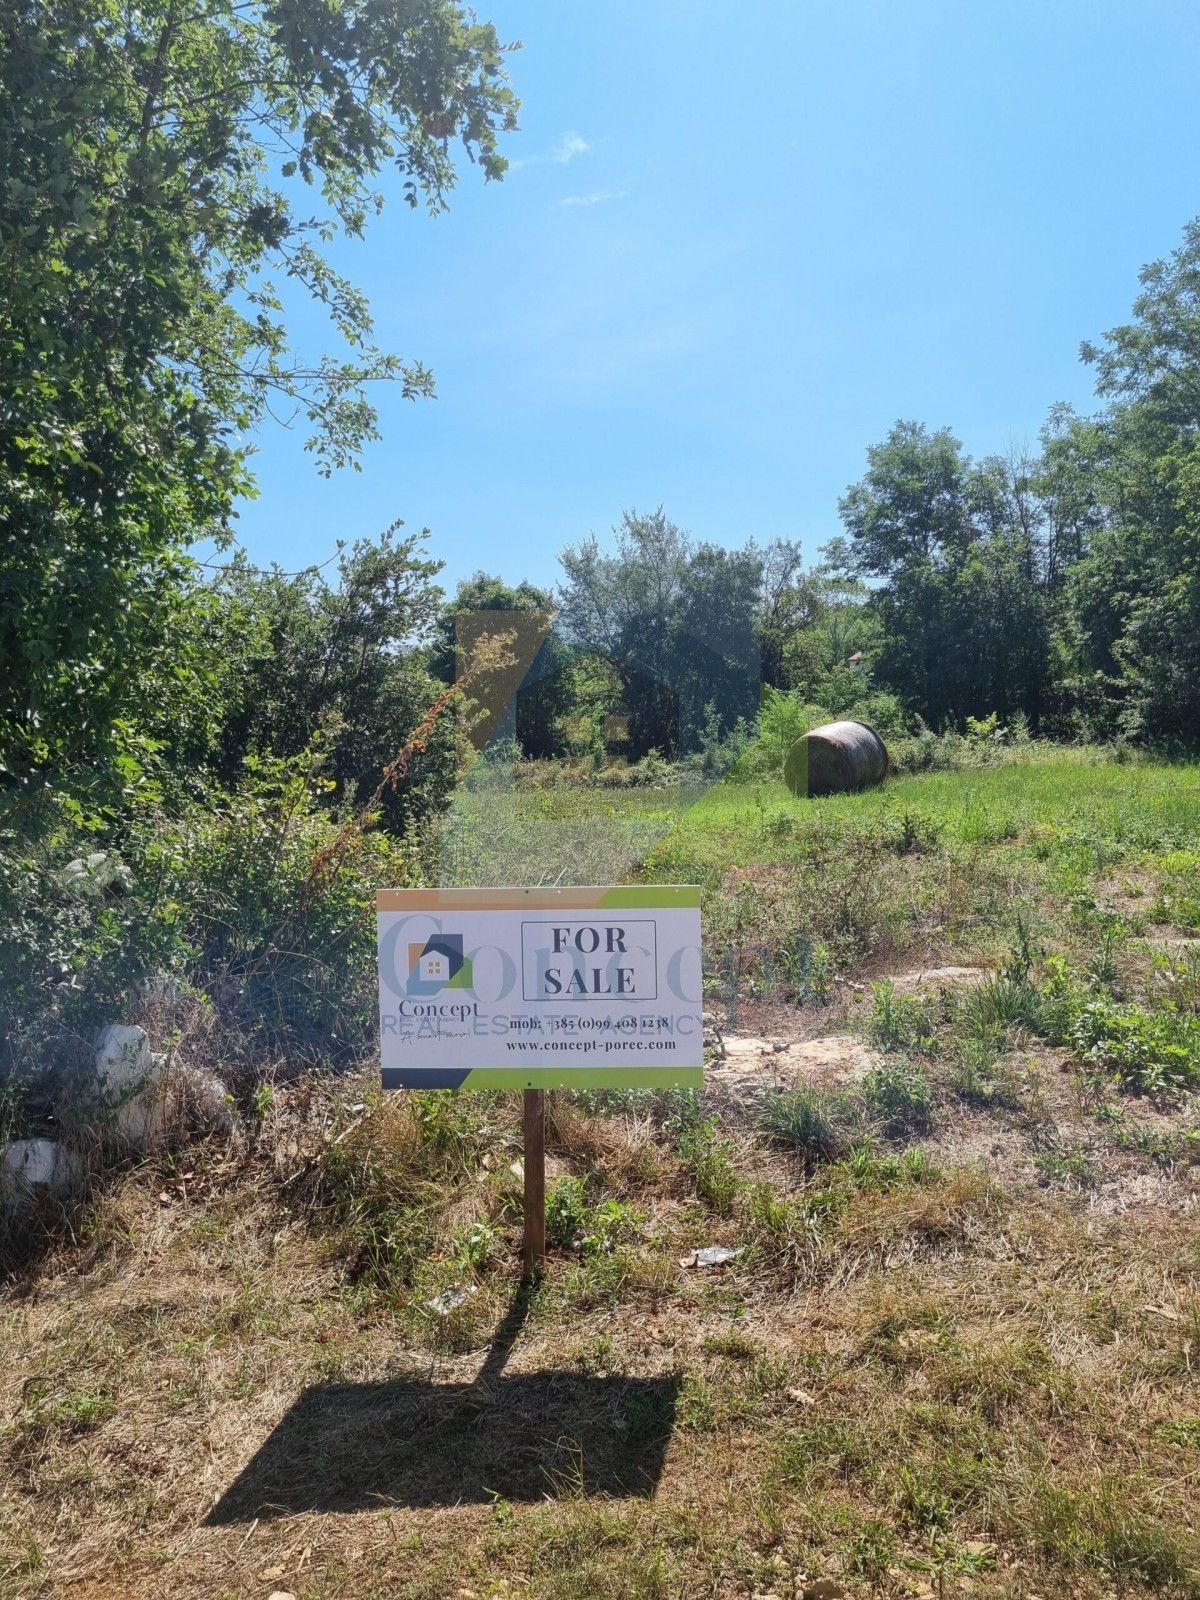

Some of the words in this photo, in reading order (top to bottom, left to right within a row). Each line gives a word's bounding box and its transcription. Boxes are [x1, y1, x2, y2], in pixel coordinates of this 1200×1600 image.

[551, 927, 628, 954] FOR
[544, 968, 635, 995] SALE
[399, 1000, 479, 1022] Concept
[509, 1018, 542, 1029] mob:
[546, 1017, 575, 1031] +385
[577, 1017, 611, 1031] (0)99
[614, 1017, 638, 1030] 408
[641, 1016, 669, 1030] 1238
[506, 1039, 677, 1052] www.concept-porec.com
